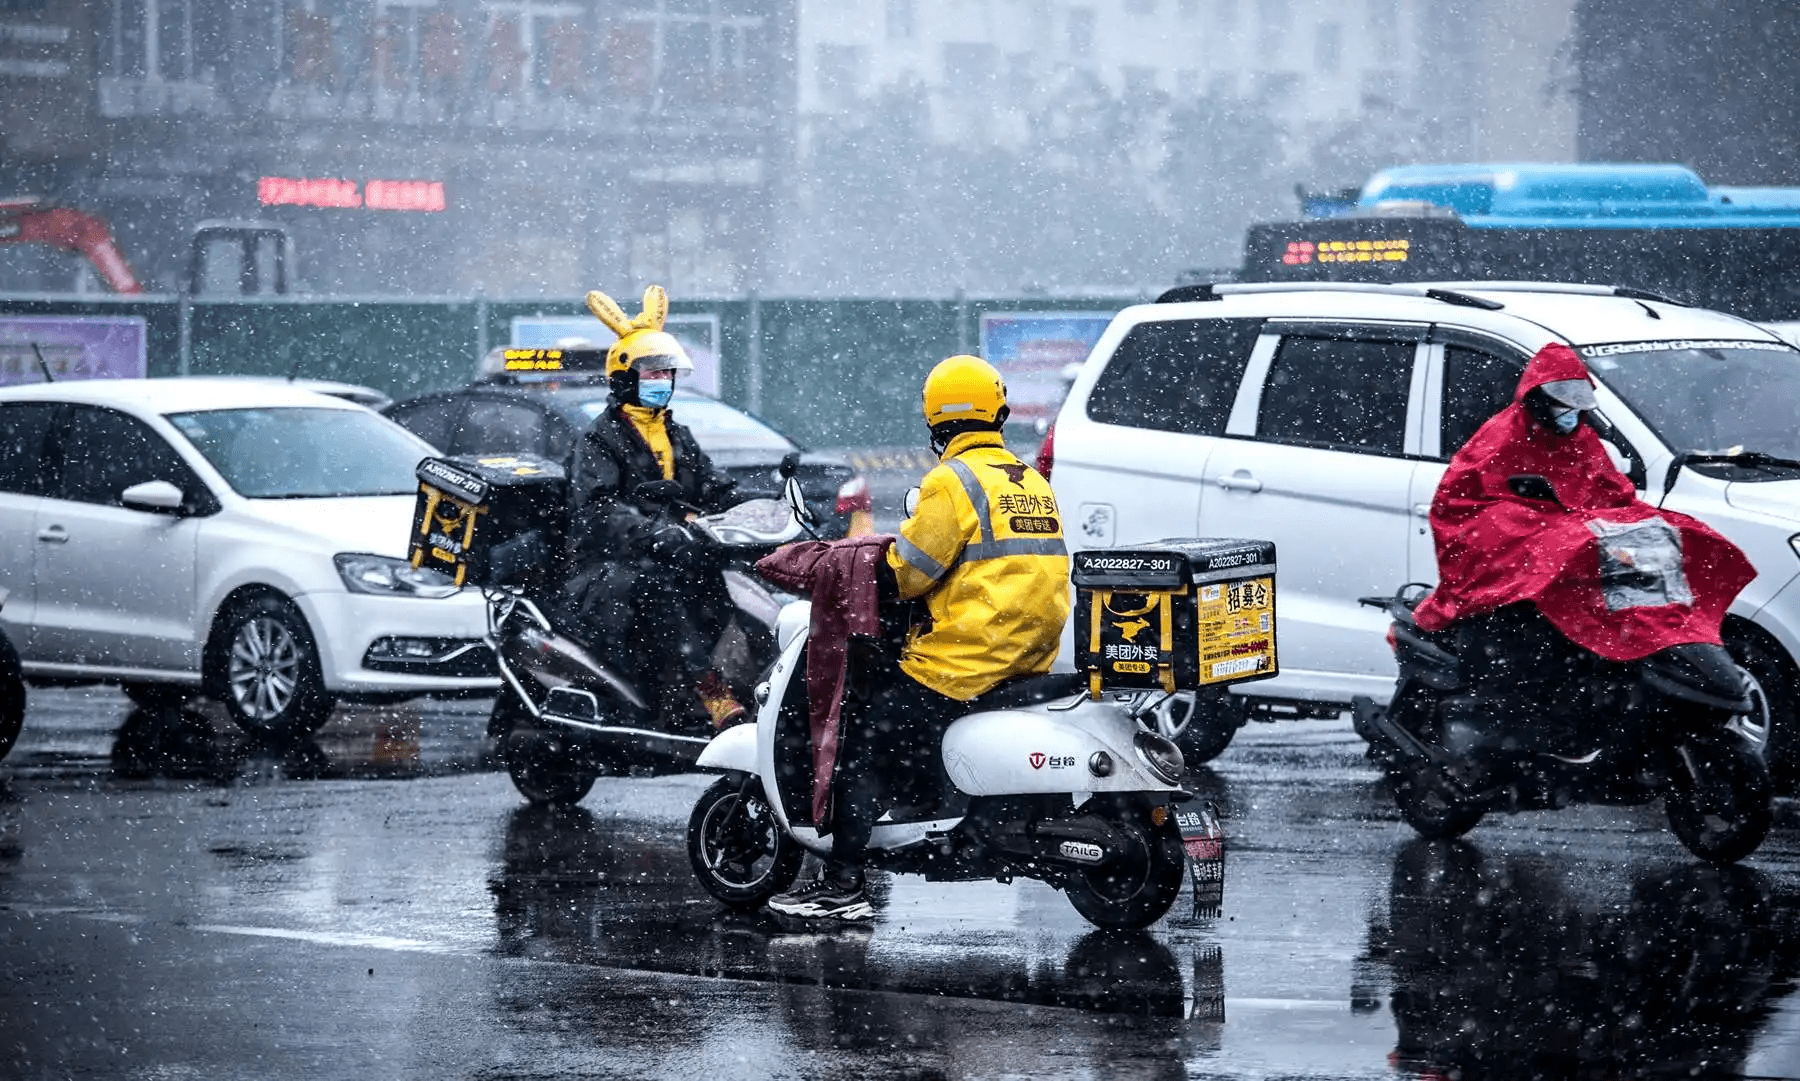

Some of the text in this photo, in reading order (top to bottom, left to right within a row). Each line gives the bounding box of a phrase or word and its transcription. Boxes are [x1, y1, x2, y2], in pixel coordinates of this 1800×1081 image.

[998, 494, 1055, 514] 美团外卖
[1015, 519, 1052, 531] 美团专送
[1084, 558, 1171, 570] A2022827-301
[1208, 552, 1258, 569] A2022827-301
[1227, 583, 1267, 612] 招募令
[1105, 643, 1158, 660] 美团外卖
[1049, 756, 1075, 766] 台铃
[1064, 845, 1099, 857] TAILG
